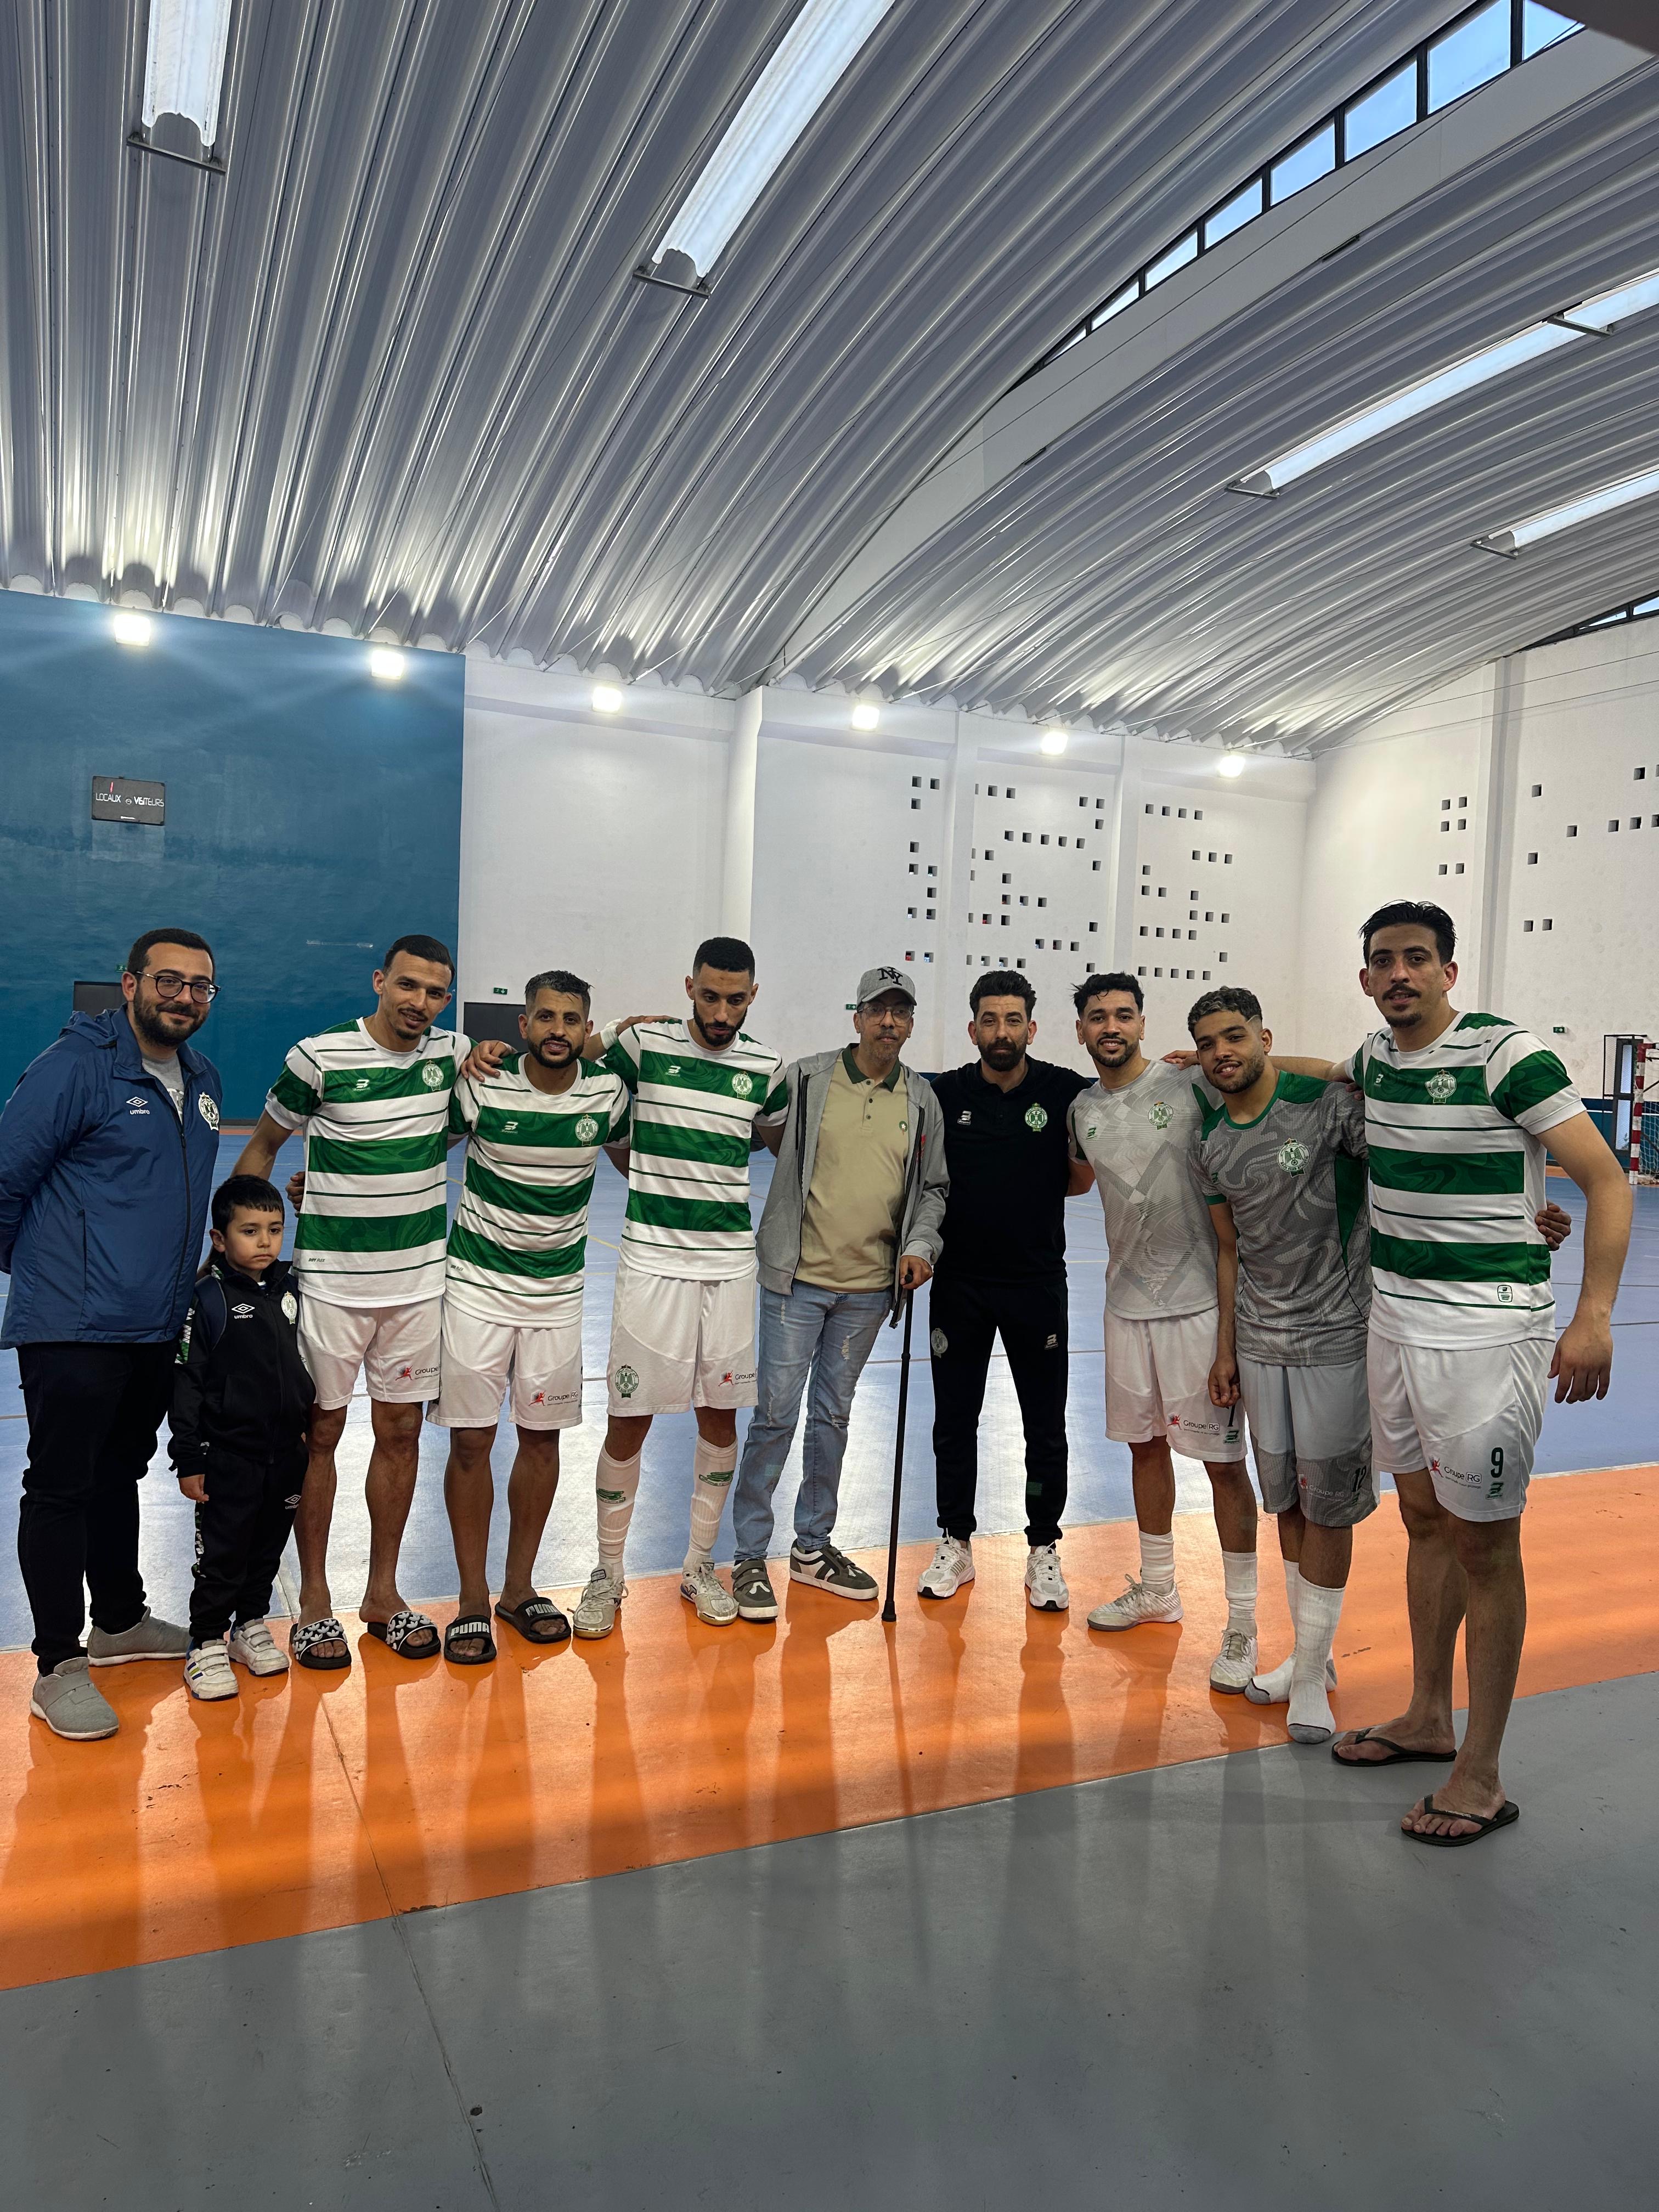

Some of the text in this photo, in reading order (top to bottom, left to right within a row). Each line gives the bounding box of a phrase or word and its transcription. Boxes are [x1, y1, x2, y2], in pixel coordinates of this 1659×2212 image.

[95, 792, 164, 807] LOCAUX VISITEURS
[877, 967, 904, 986] NY
[1183, 1420, 1206, 1430] Groupe
[1491, 1447, 1504, 1478] 9
[1351, 1465, 1367, 1492] 12
[1444, 1466, 1465, 1480] Groupe
[1467, 1474, 1481, 1482] RG
[1309, 1485, 1334, 1496] Groupe
[450, 1622, 490, 1637] PUMA
